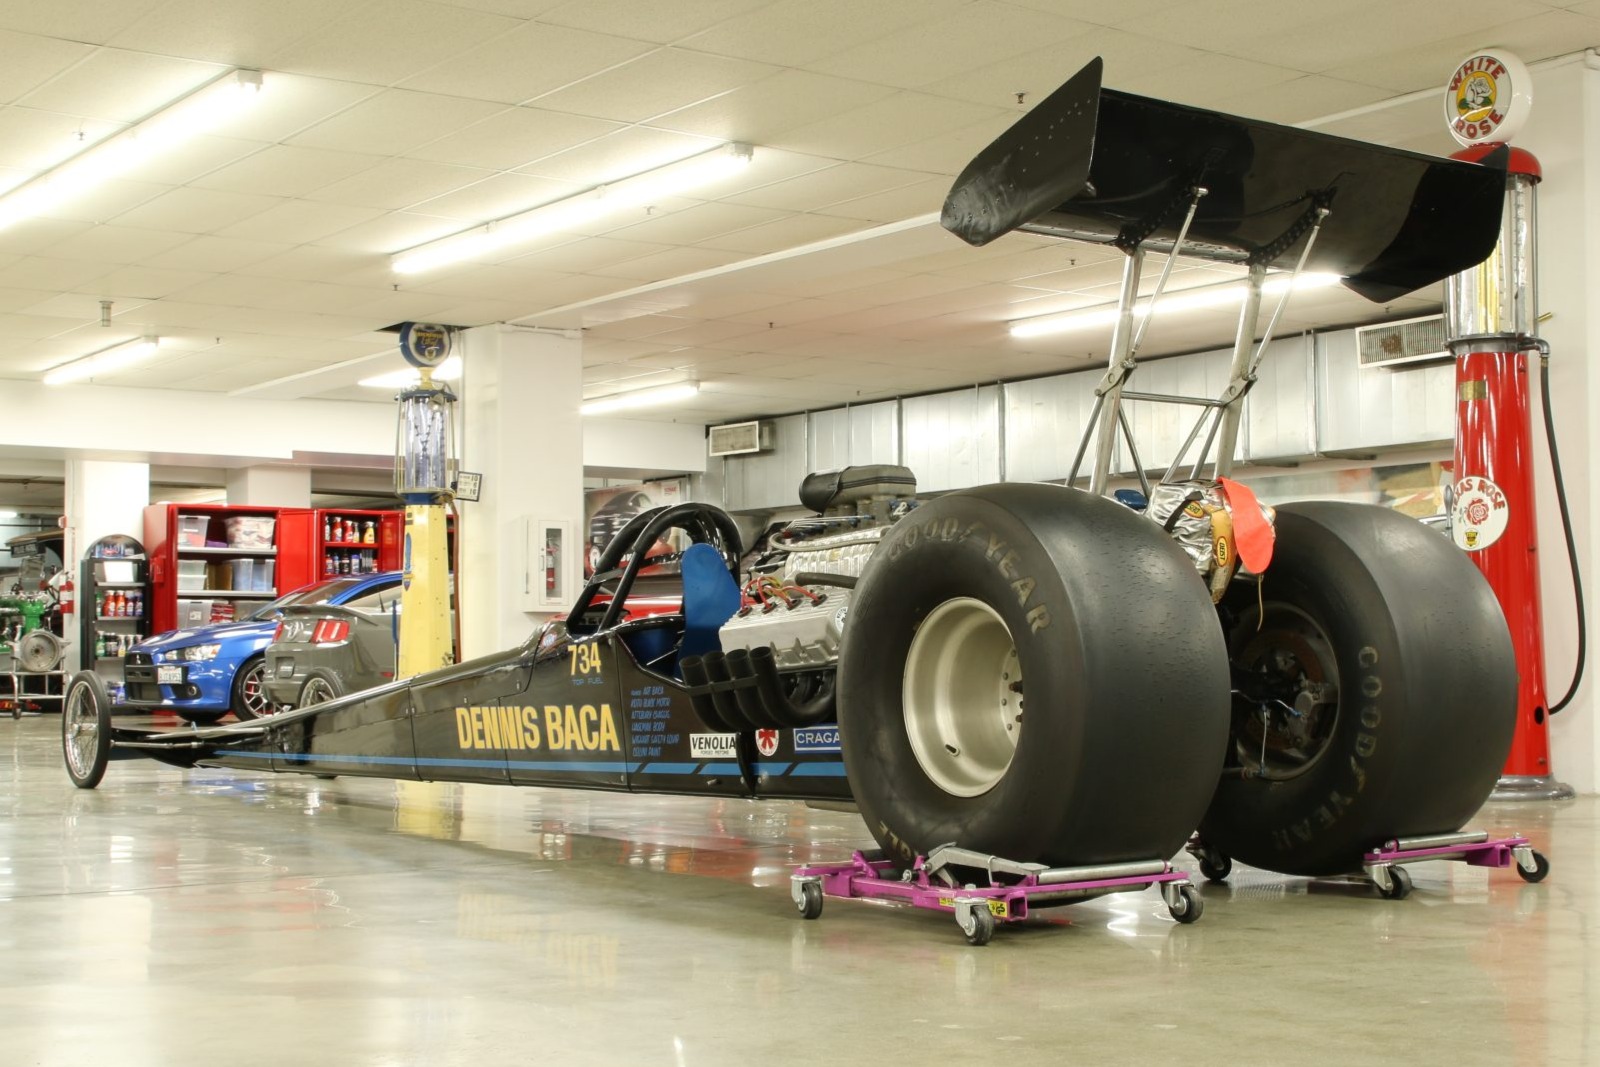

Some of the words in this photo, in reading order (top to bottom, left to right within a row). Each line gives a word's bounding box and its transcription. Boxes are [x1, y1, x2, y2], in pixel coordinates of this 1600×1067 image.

[1450, 57, 1505, 92] WHITE
[1455, 109, 1504, 139] ROSE
[1477, 479, 1506, 511] ROSE
[567, 641, 602, 676] 734
[588, 677, 605, 685] FUEL
[455, 704, 541, 750] DENNIS
[543, 702, 621, 752] BACA
[691, 736, 736, 750] VENOLIA
